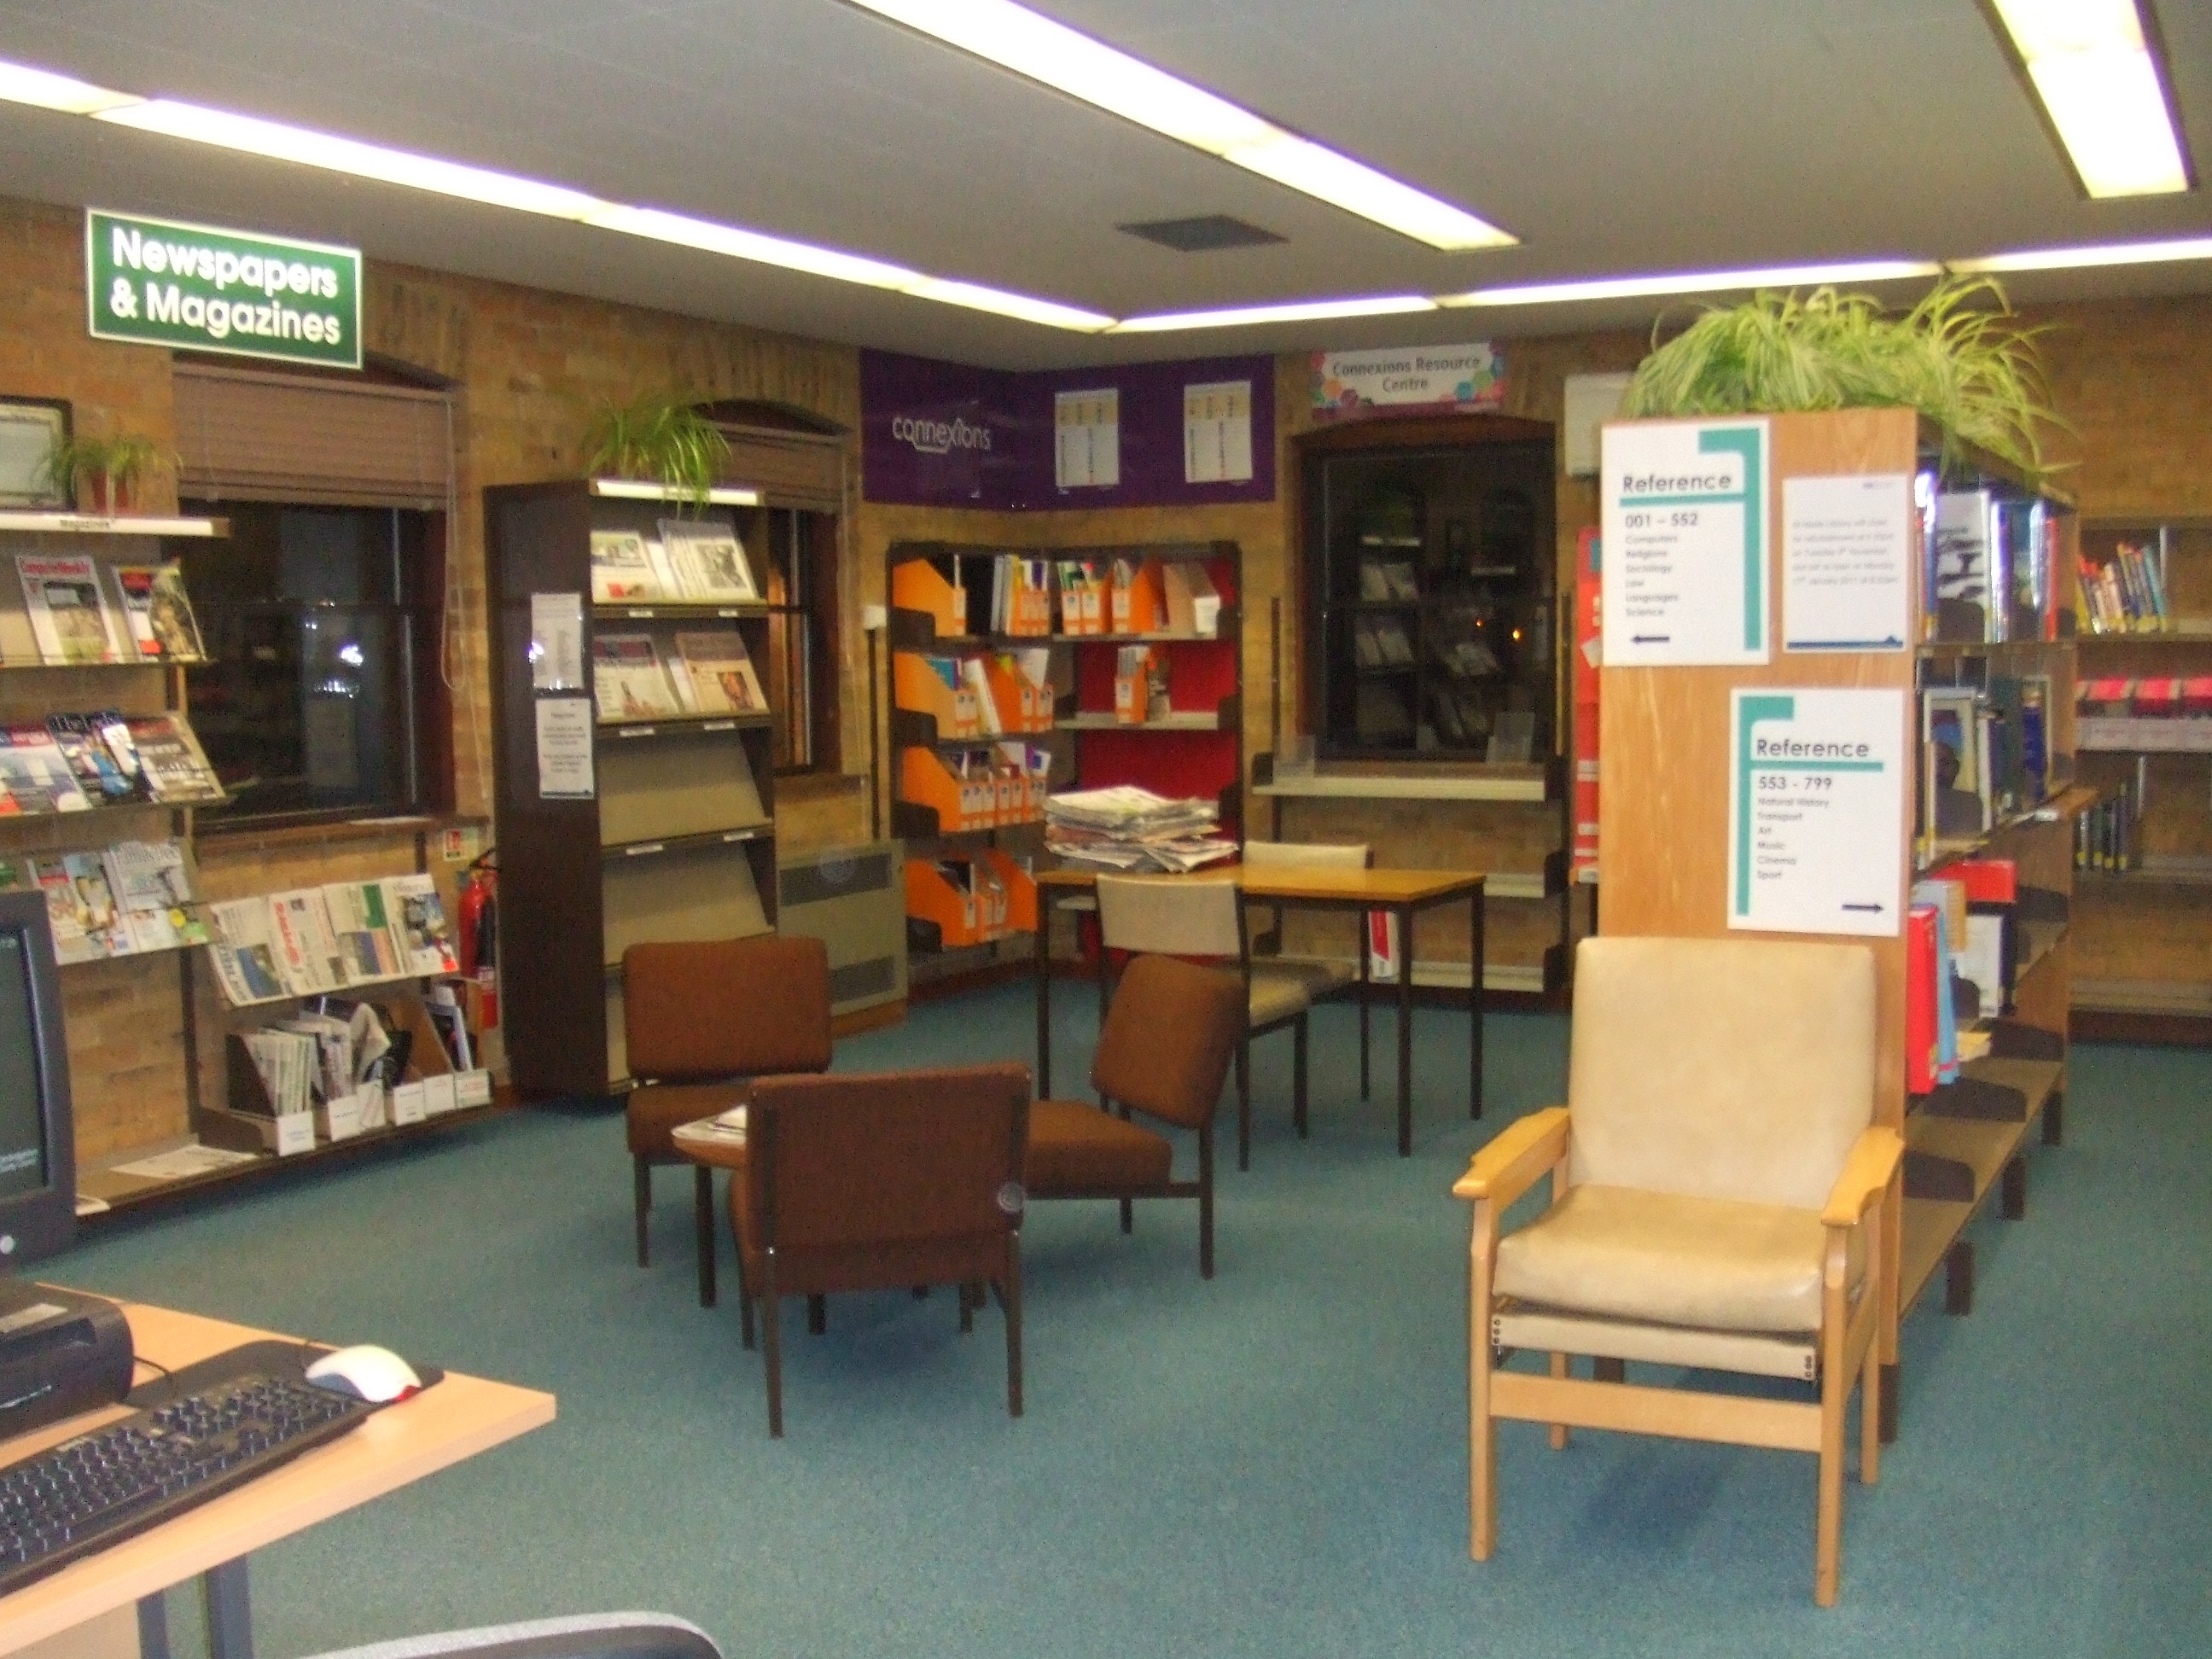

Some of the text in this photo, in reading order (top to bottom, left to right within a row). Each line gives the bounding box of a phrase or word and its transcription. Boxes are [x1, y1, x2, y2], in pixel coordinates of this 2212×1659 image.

[112, 227, 338, 299] Newspapers
[109, 277, 341, 345] & Magazines
[1332, 356, 1481, 376] Connexions Resource
[1382, 376, 1430, 393] Centre
[892, 417, 991, 453] connexions
[1622, 473, 1732, 493] Reference
[1625, 515, 1651, 528] 001
[1671, 514, 1698, 527] 552
[1625, 535, 1678, 545] Computers
[1625, 565, 1673, 574] Sociology
[1625, 593, 1679, 603] Languages
[1625, 607, 1665, 616] Science
[1756, 738, 1870, 758] Reference
[1758, 777, 1786, 790] 553
[1804, 777, 1833, 790] 799
[1758, 797, 1830, 809] Natural History
[1758, 812, 1802, 822] Transport
[1757, 841, 1786, 850] Music
[1757, 855, 1796, 865] Cinema
[1757, 870, 1782, 880] Sport
